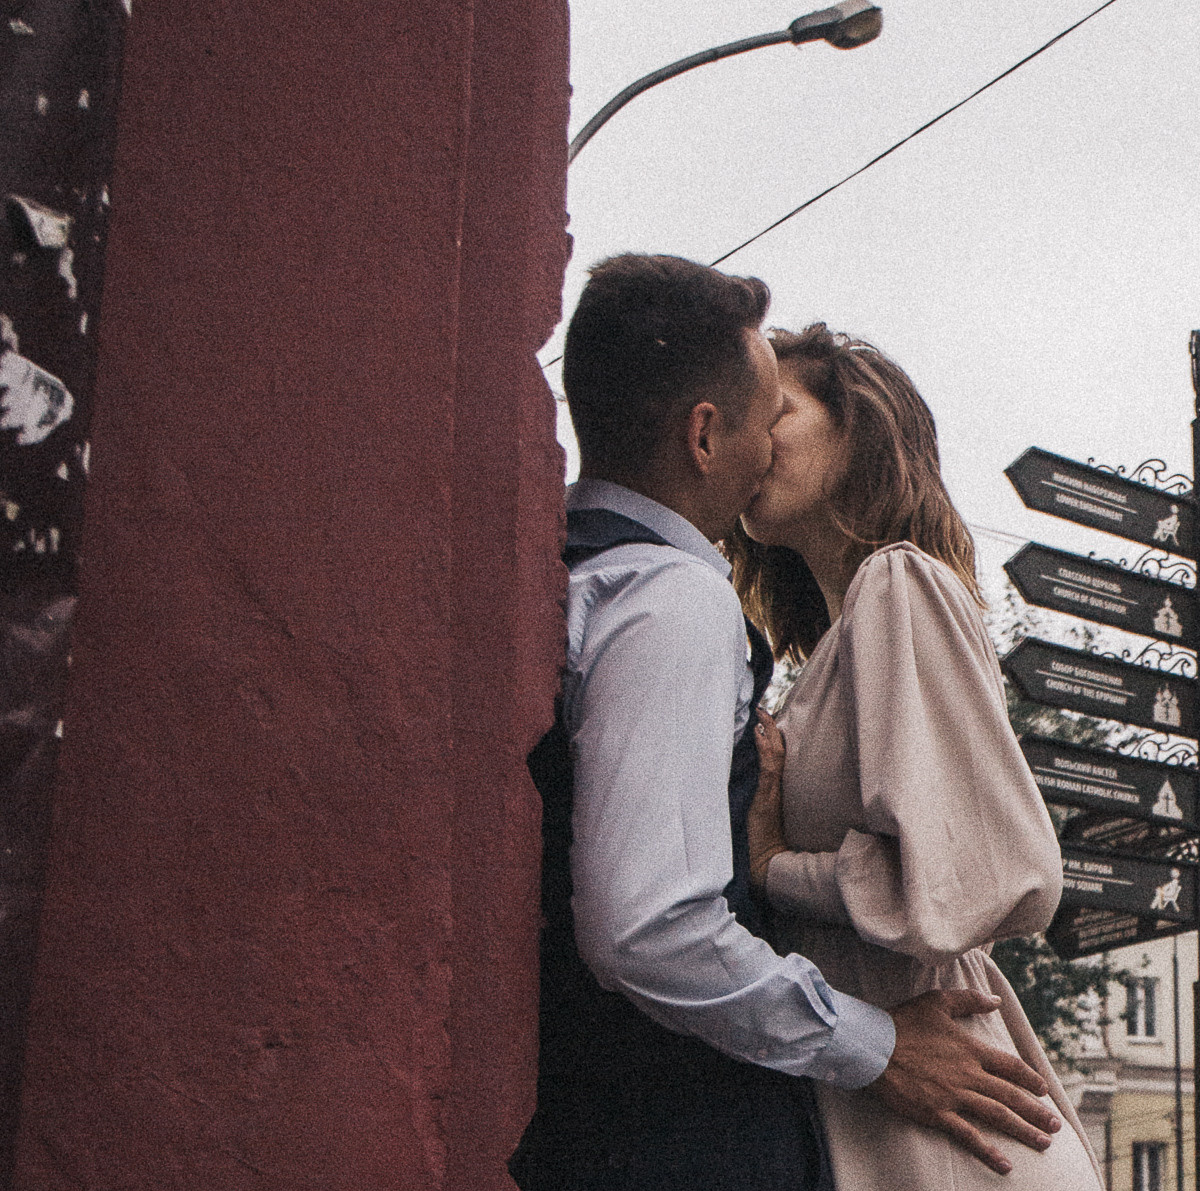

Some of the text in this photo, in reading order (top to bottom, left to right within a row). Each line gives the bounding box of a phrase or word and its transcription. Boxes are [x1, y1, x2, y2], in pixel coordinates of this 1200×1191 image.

[1052, 586, 1080, 601] CHURCH
[1045, 679, 1072, 692] CHURCH
[1082, 687, 1094, 698] THE
[1053, 758, 1091, 773] ПОЛЬСКИЙ
[1082, 784, 1112, 798] CATHOLIC
[1113, 790, 1140, 803] CHURCH
